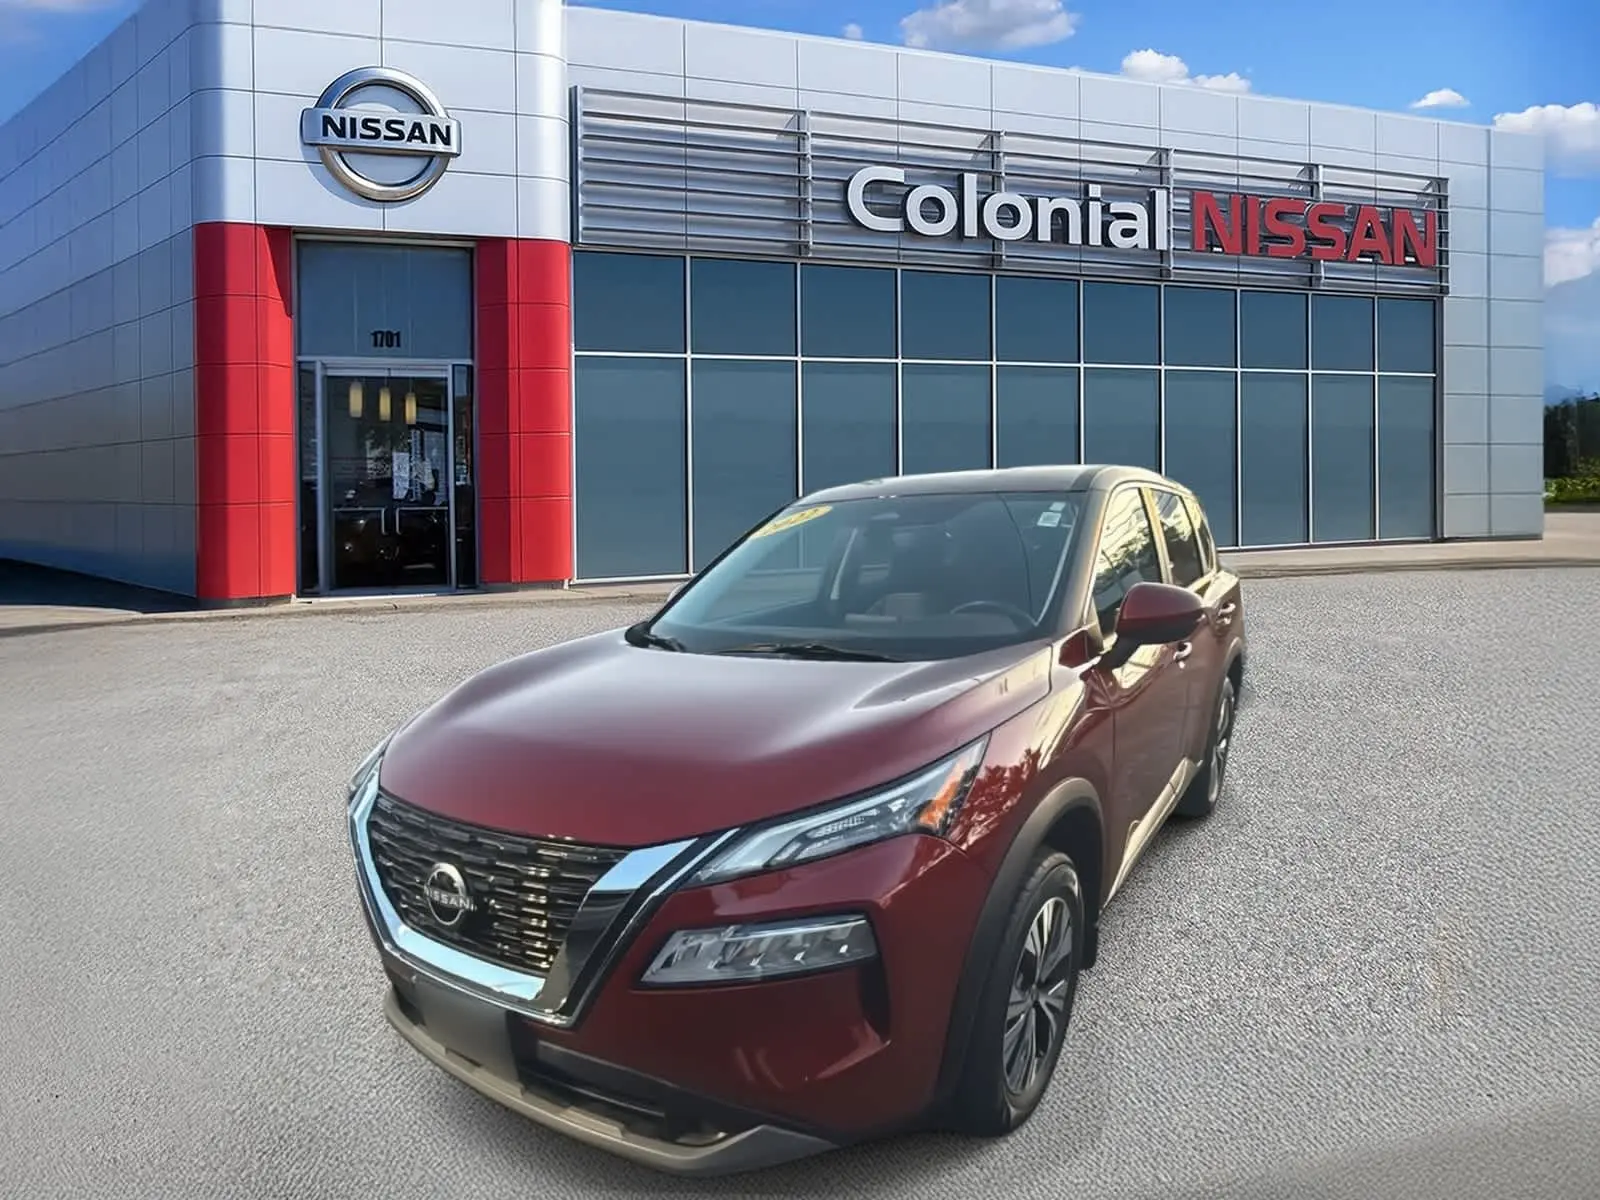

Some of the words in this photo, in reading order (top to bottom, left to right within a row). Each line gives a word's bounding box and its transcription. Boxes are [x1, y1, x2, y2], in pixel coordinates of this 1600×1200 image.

[322, 115, 451, 145] NISSAN
[847, 166, 1168, 250] Colonial
[1192, 190, 1436, 267] NISSAN
[371, 331, 401, 348] 1701
